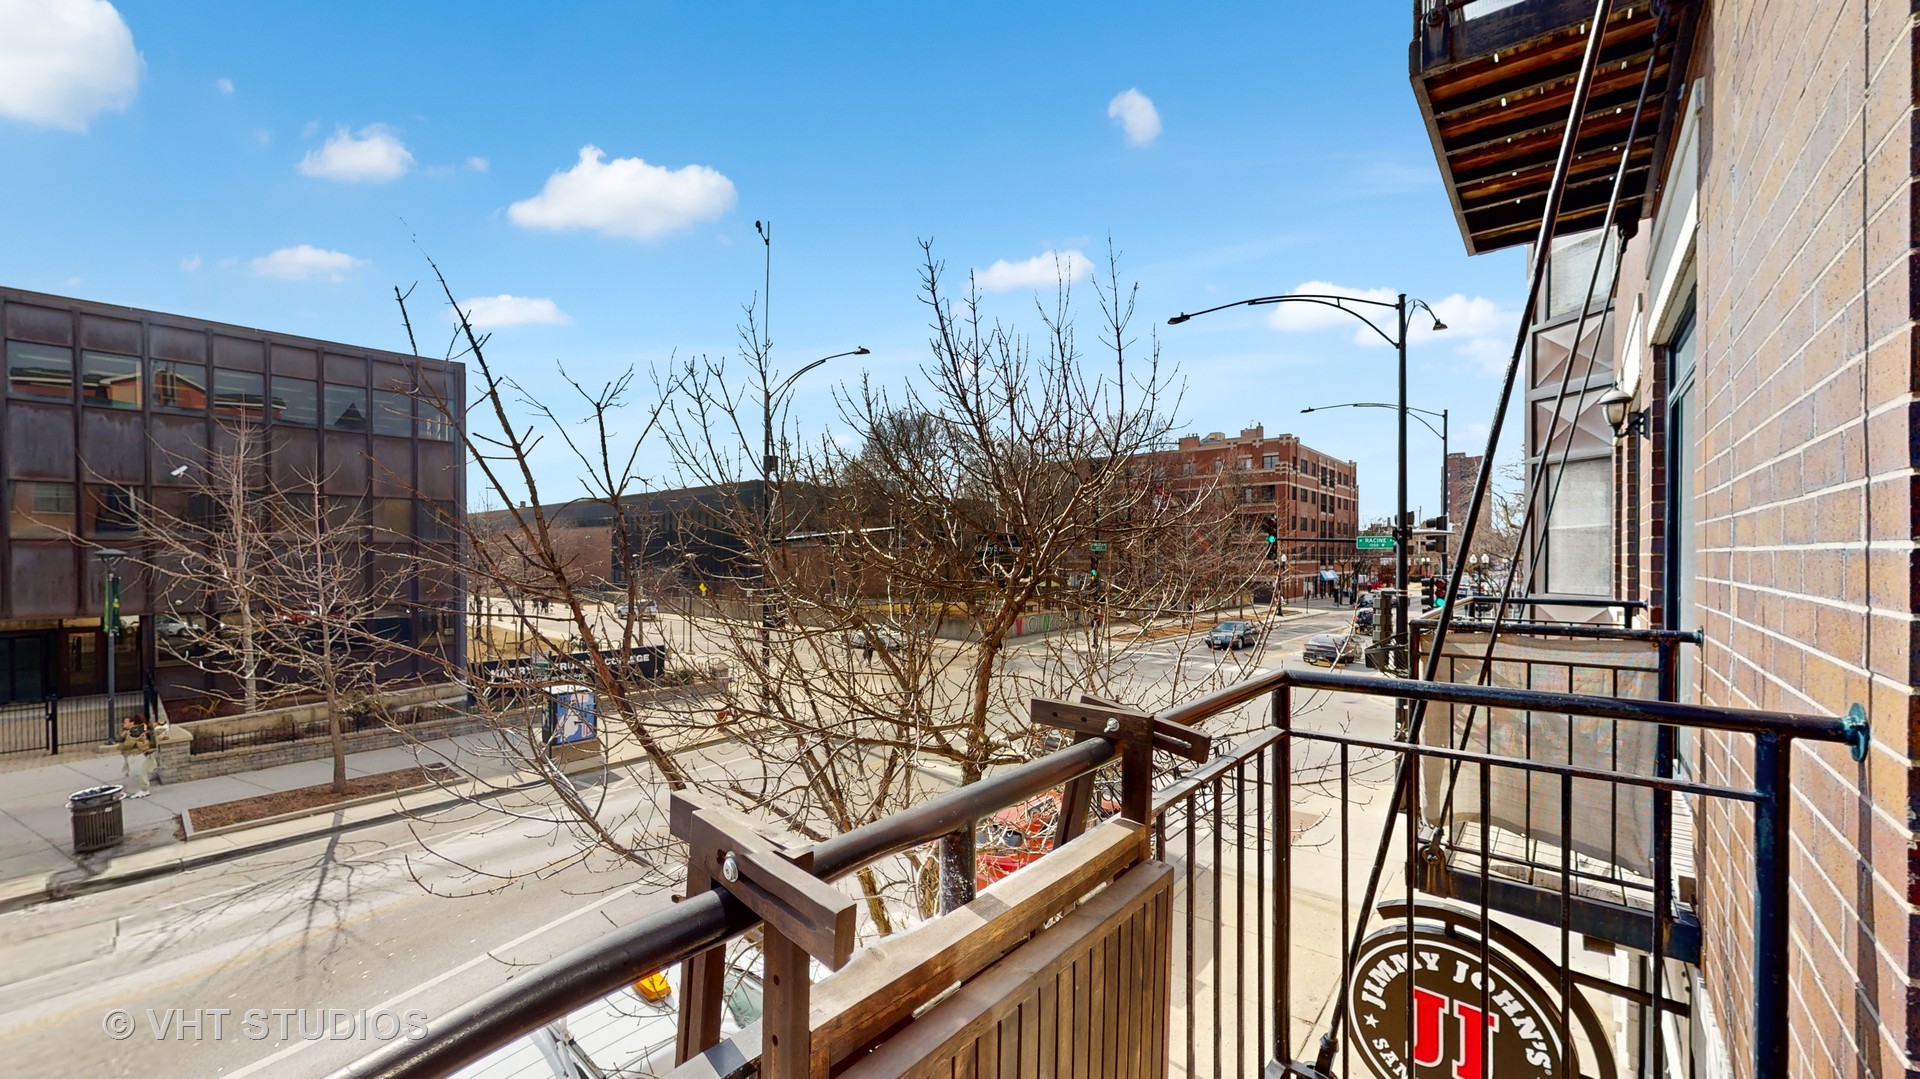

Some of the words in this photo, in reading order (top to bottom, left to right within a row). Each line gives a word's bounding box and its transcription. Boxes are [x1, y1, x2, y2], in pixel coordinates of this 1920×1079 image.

[604, 653, 650, 666] COEGE
[1361, 951, 1440, 1010] JIMMY
[1453, 960, 1552, 1069] JOHN'S
